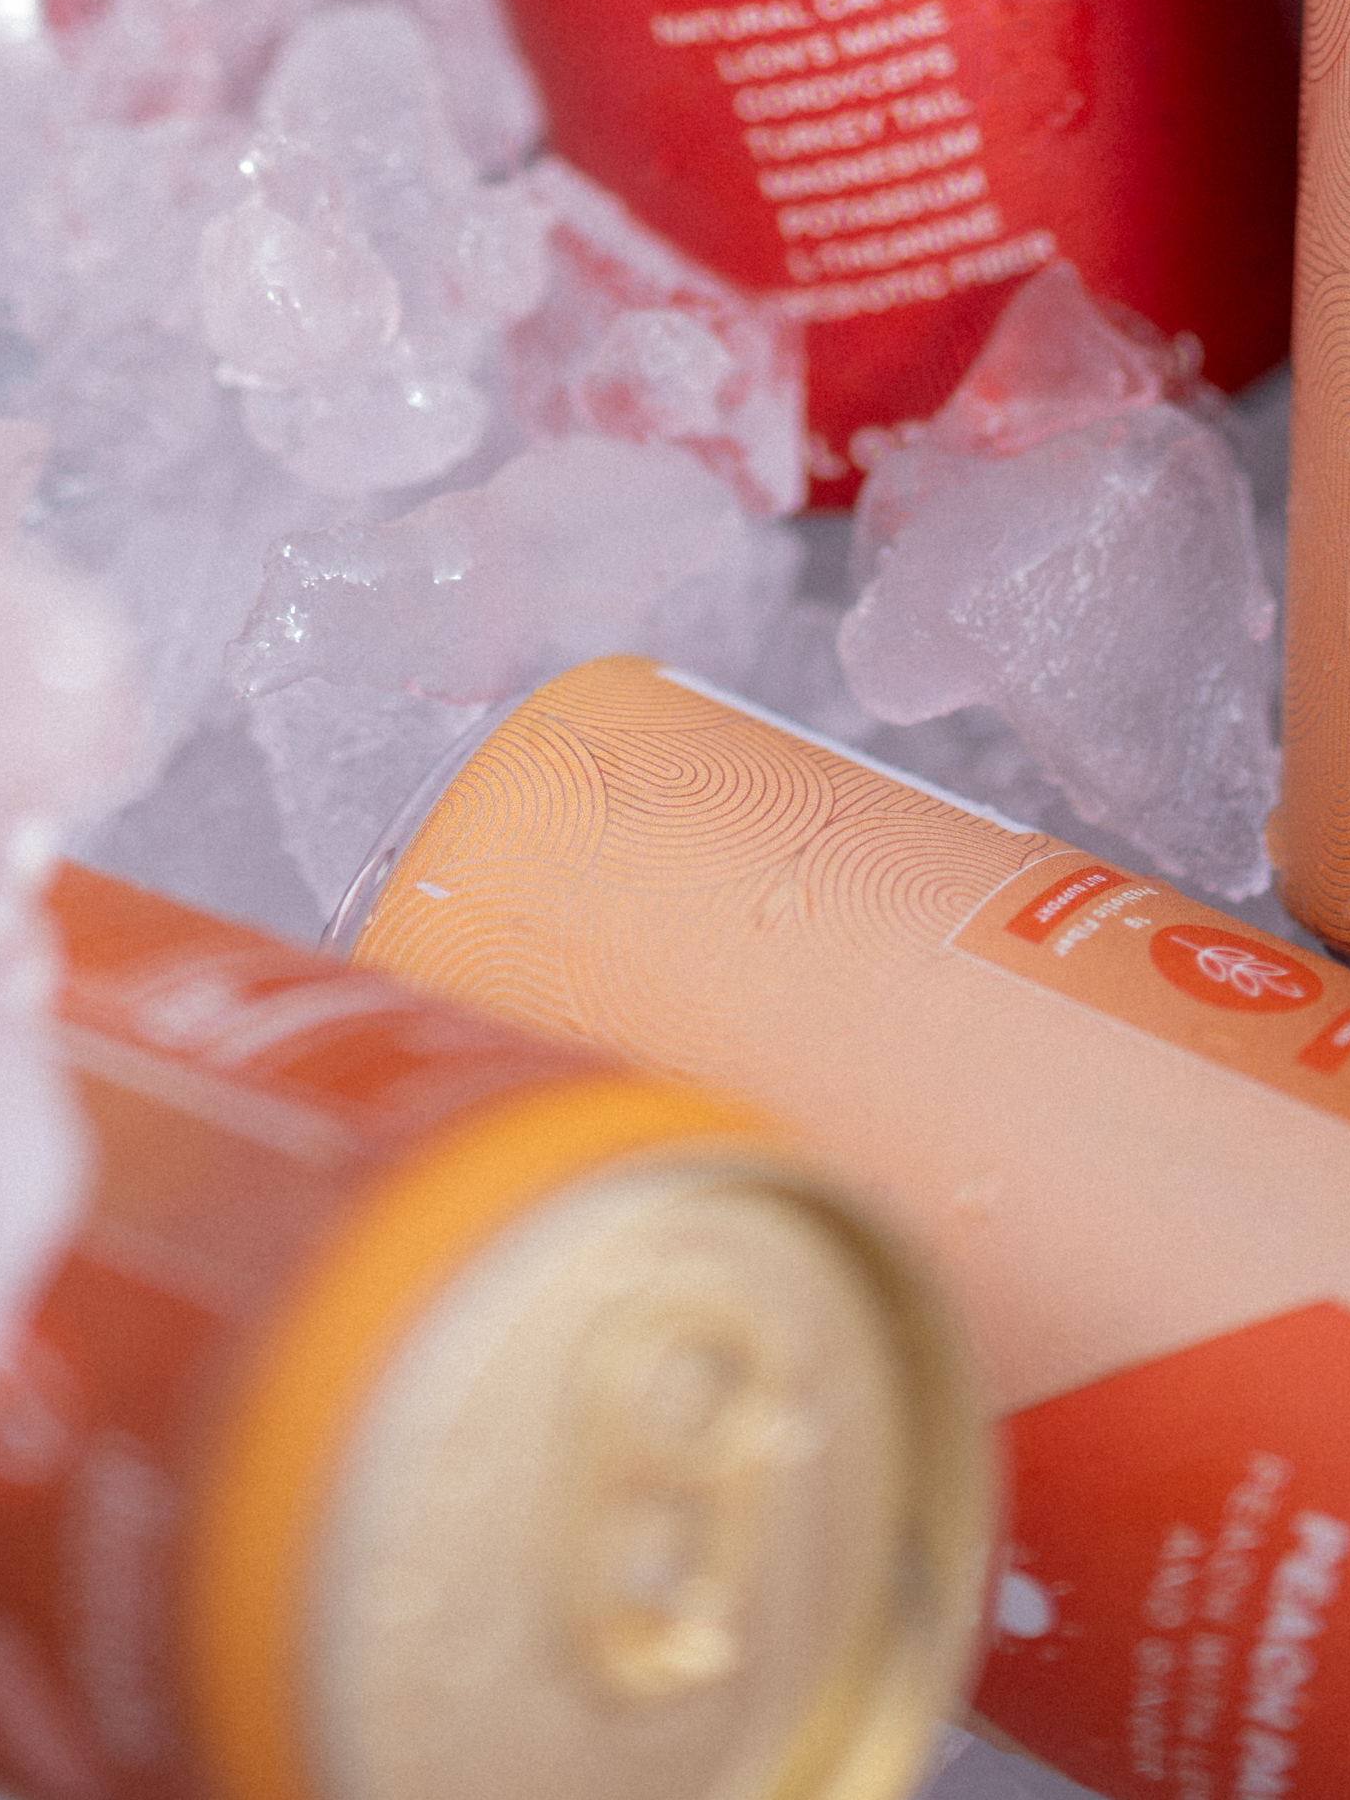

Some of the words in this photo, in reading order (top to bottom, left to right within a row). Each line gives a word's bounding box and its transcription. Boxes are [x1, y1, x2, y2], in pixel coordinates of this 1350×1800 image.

[1083, 873, 1108, 888] GUT
[1033, 883, 1088, 924] SUPPORT
[1091, 885, 1161, 919] Prebiotic
